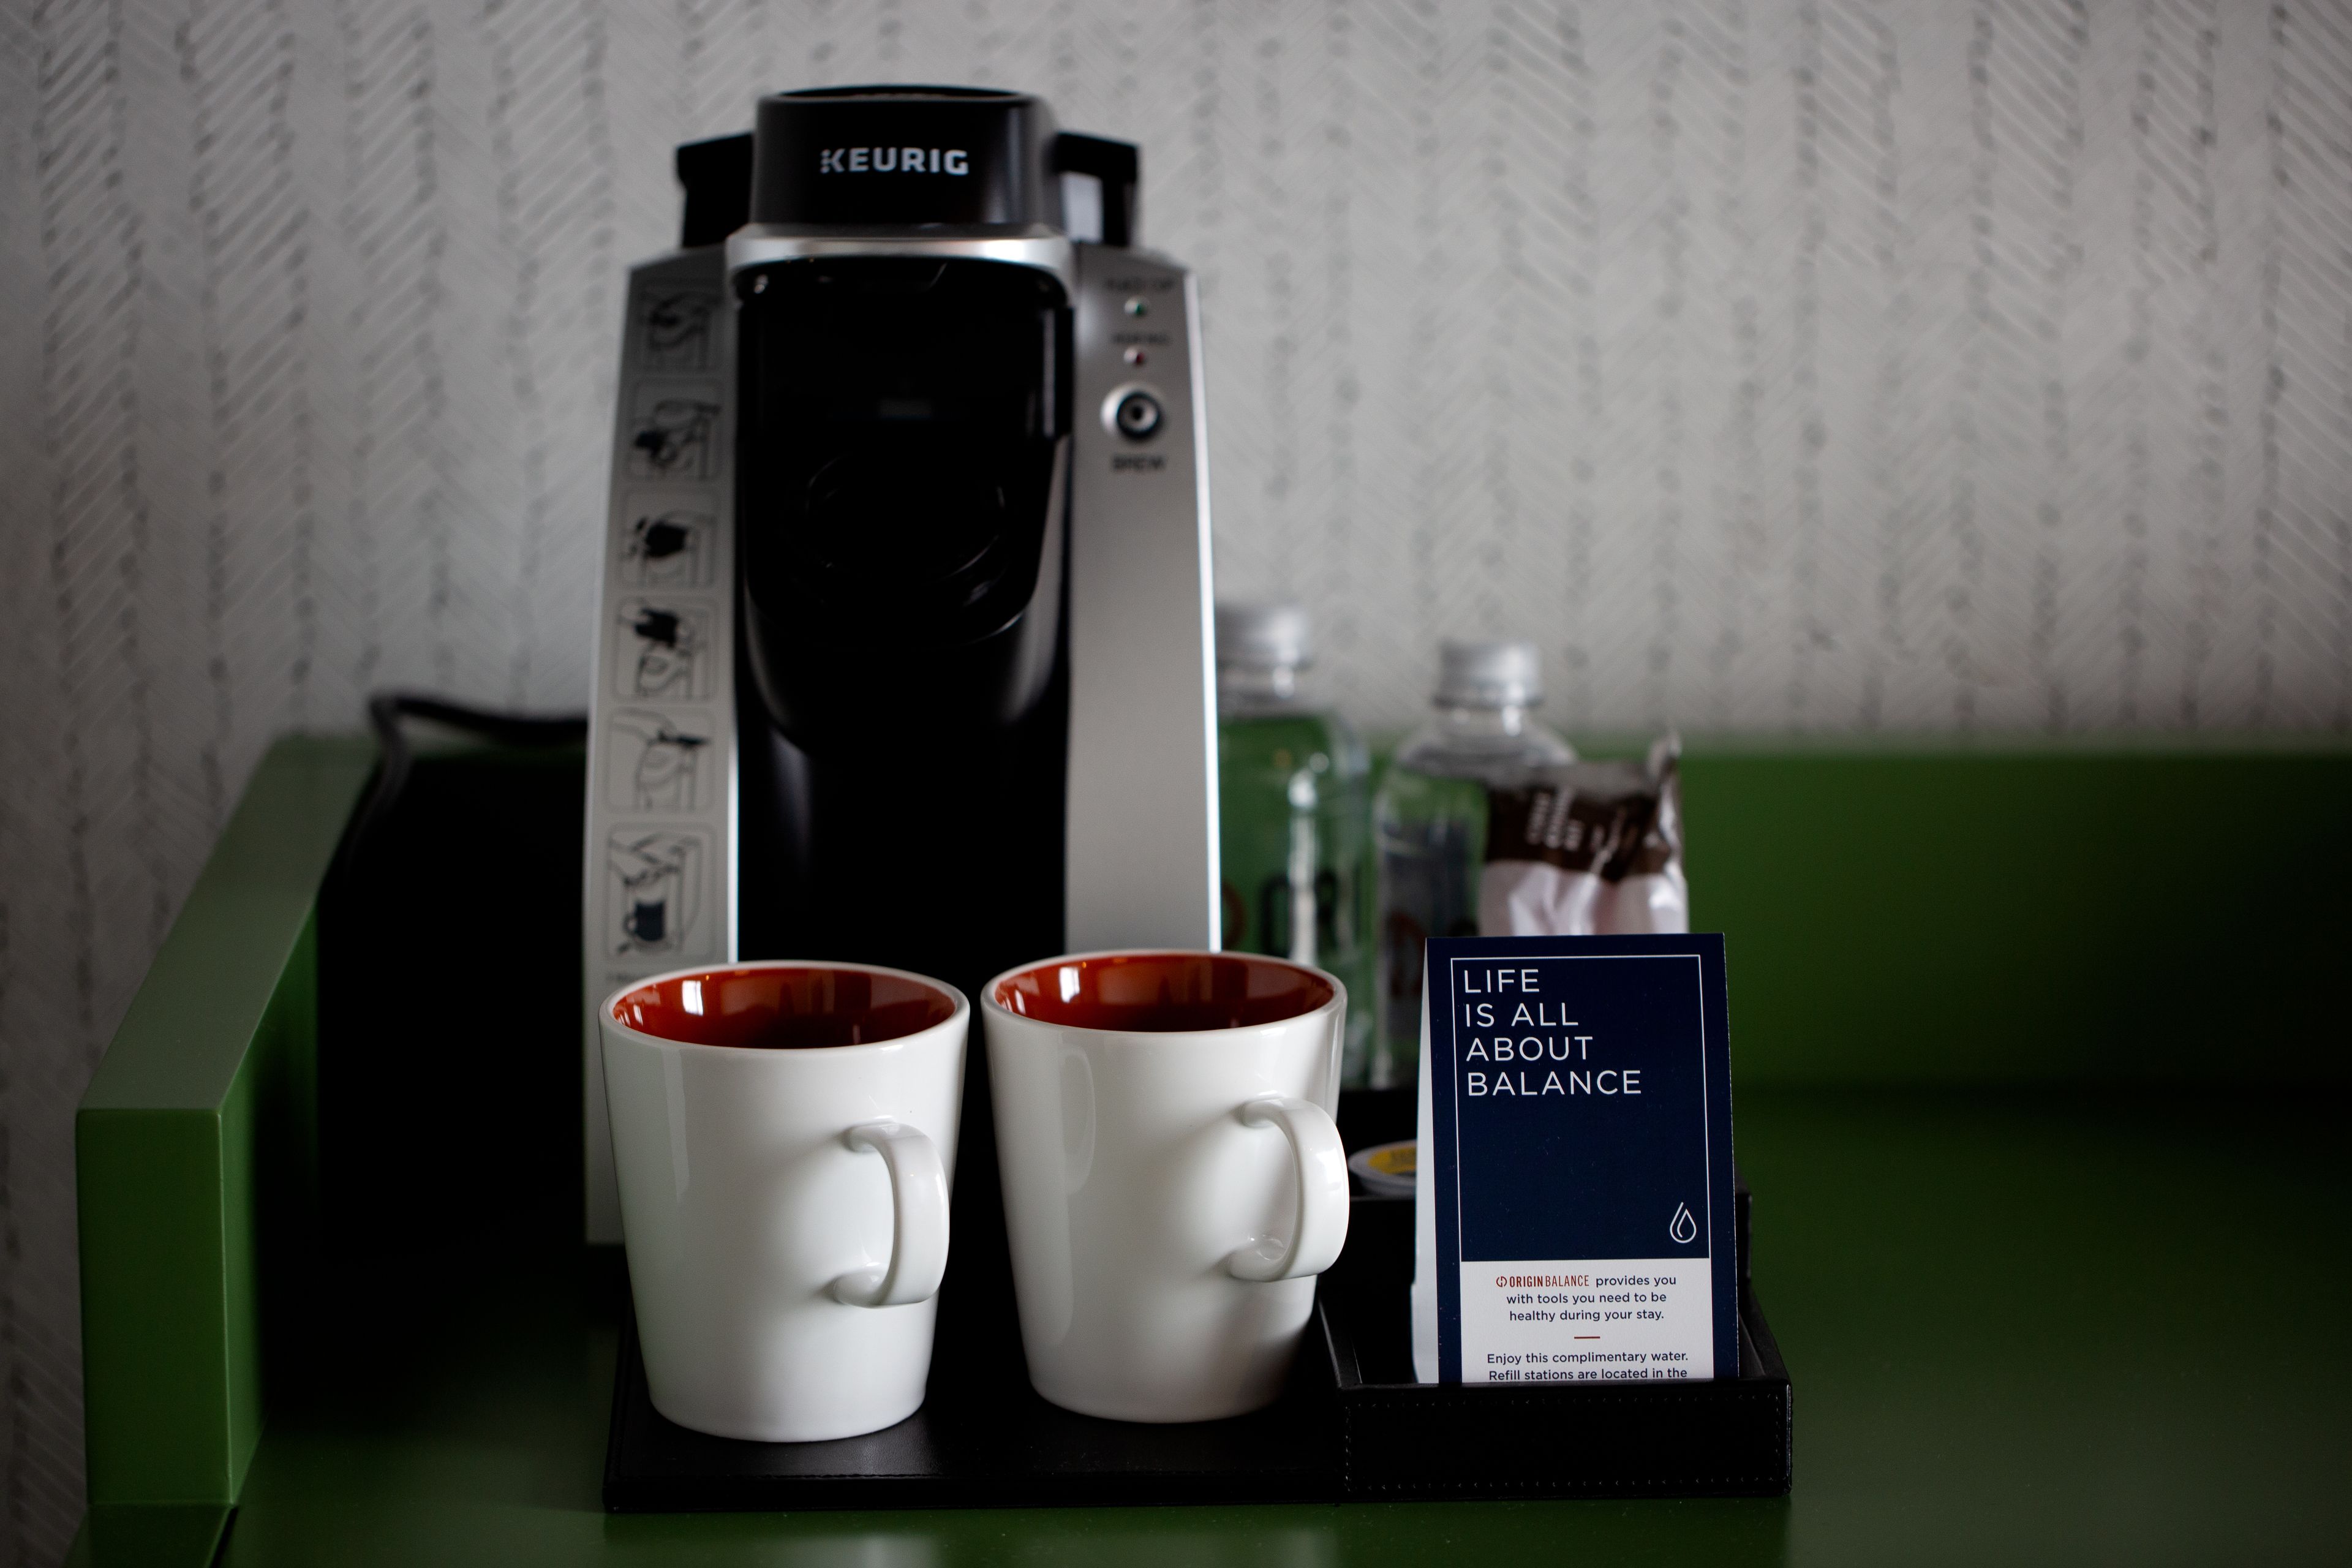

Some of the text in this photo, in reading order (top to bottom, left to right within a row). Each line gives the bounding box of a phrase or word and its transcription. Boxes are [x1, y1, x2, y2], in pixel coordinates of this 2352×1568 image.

[821, 147, 969, 175] KEURIG
[1464, 968, 1540, 993] LIFE
[1465, 1002, 1579, 1027] IS ALL
[1466, 1036, 1593, 1061] ABOUT
[1468, 1070, 1642, 1096] BALANCE
[1596, 1275, 1650, 1288] provides
[1654, 1276, 1676, 1287] you
[1506, 1291, 1667, 1305] with tools you need to be
[1510, 1309, 1664, 1322] healthy during your stay.
[1487, 1351, 1688, 1365] Enjoy this complimentary water.
[1489, 1367, 1687, 1381] Refill stations are located in the
